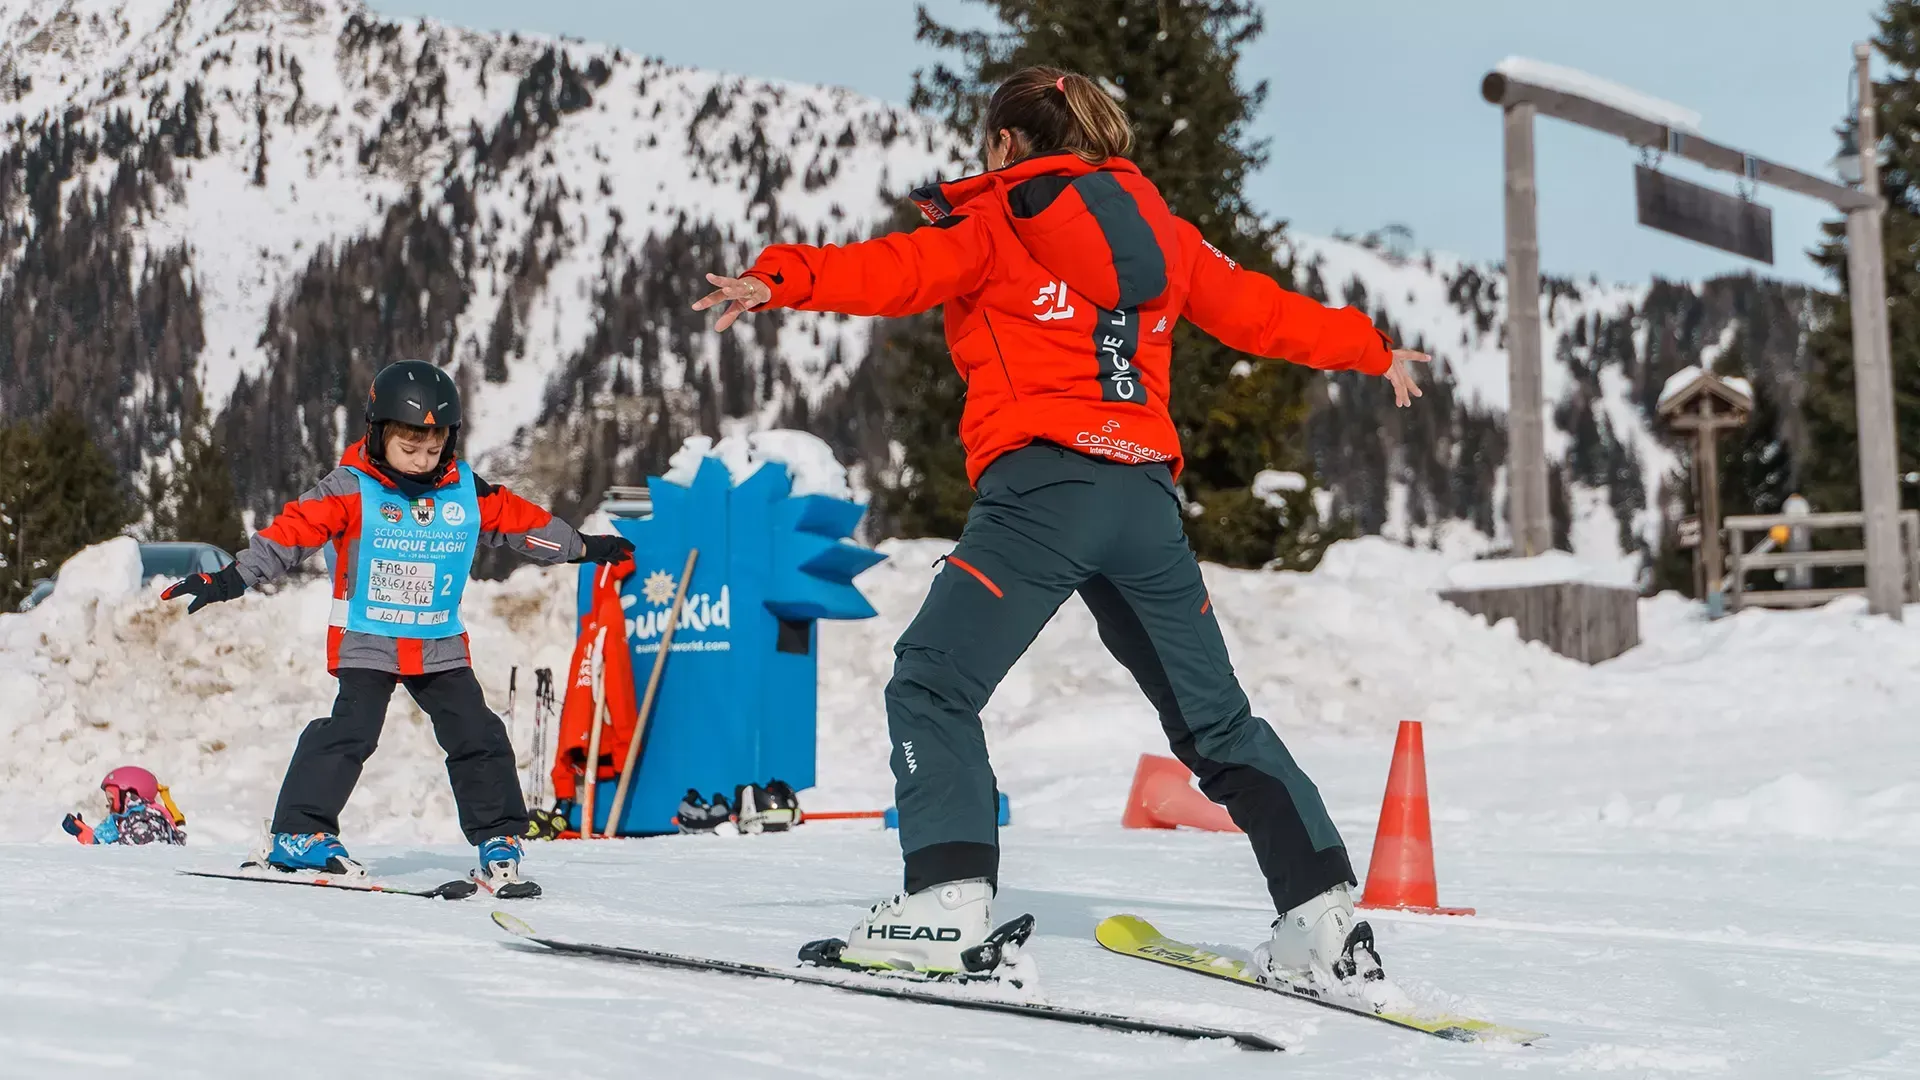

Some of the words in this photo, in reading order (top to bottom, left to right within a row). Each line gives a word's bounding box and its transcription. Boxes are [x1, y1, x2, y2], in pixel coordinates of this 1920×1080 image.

[374, 528, 413, 538] SCUOLA
[415, 529, 454, 539] ITALIANA
[456, 531, 468, 539] SCI
[373, 538, 427, 552] CINQUE
[430, 541, 466, 553] LAGHI
[376, 561, 417, 576] FABIO
[441, 574, 453, 596] 2
[867, 924, 961, 942] HEAD
